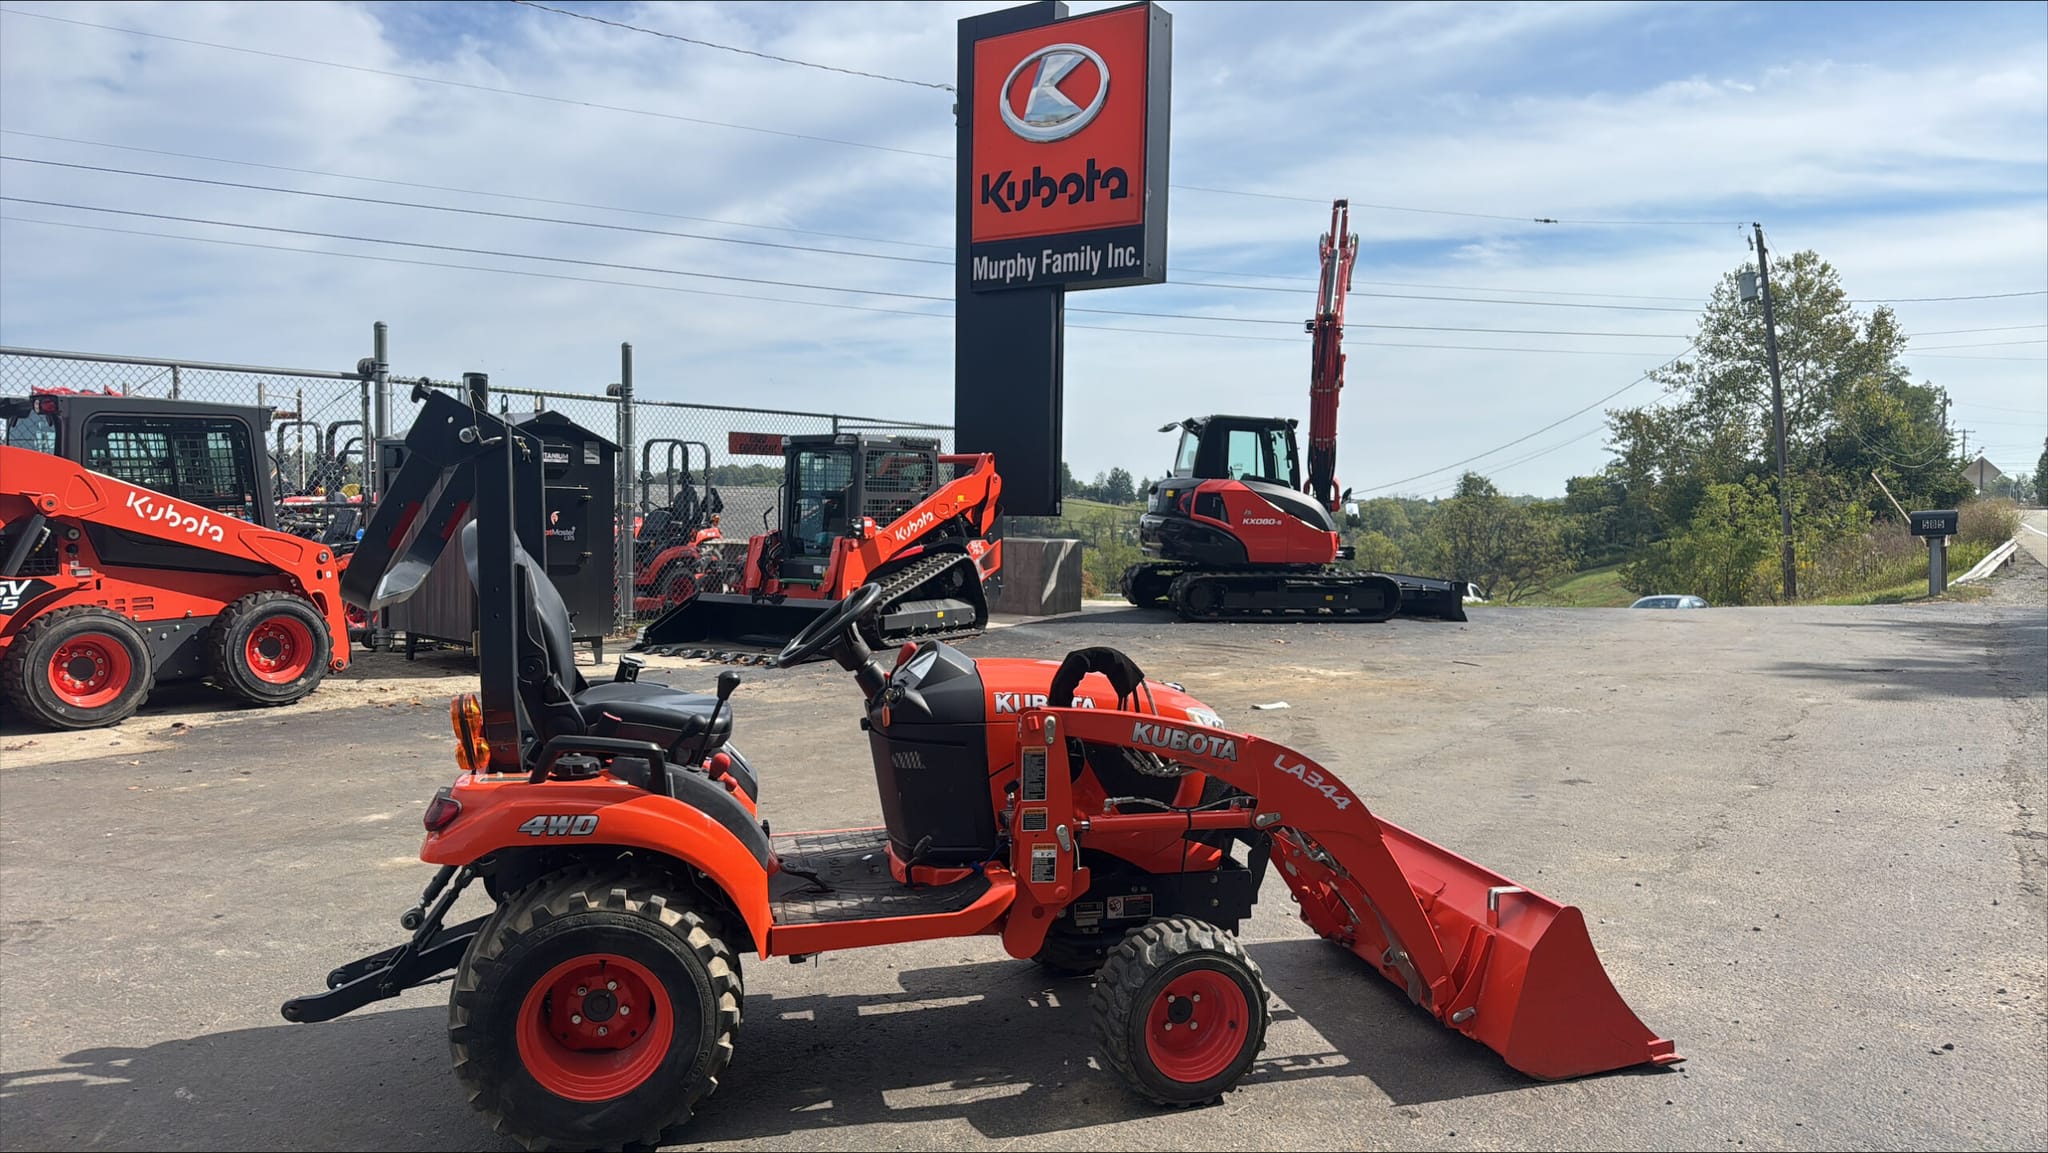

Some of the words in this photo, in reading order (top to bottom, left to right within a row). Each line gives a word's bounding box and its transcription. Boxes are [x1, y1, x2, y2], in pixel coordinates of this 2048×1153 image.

[981, 158, 1129, 213] Kubota
[973, 252, 1037, 284] Murphy
[1041, 245, 1102, 276] Family
[1107, 242, 1141, 268] Inc.
[126, 491, 224, 542] Kubota
[895, 511, 934, 540] Kubota
[993, 692, 1096, 713] KUBTA
[1131, 721, 1237, 762] KUBOTA
[1273, 754, 1352, 810] LA344
[518, 814, 600, 836] 4WD
